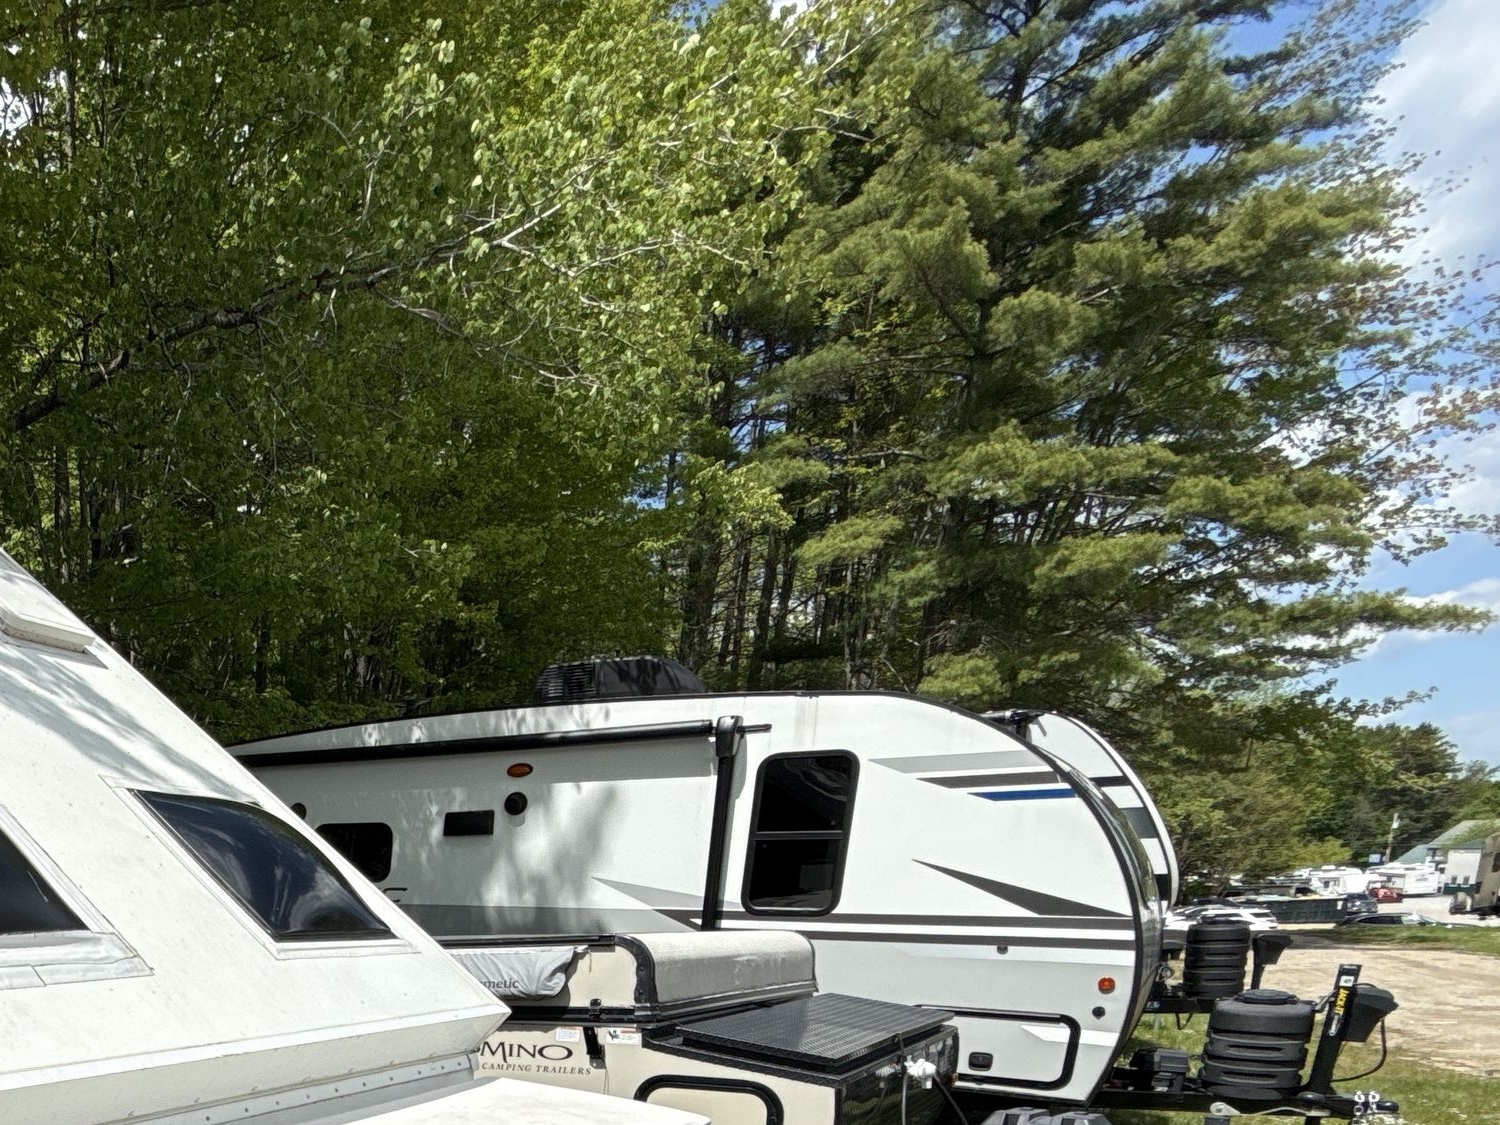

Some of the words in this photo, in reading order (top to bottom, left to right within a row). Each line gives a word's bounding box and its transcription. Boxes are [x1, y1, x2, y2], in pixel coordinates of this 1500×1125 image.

[480, 1040, 573, 1064] MINO
[481, 1062, 532, 1073] CAMPING
[536, 1064, 591, 1076] TRAILERS
